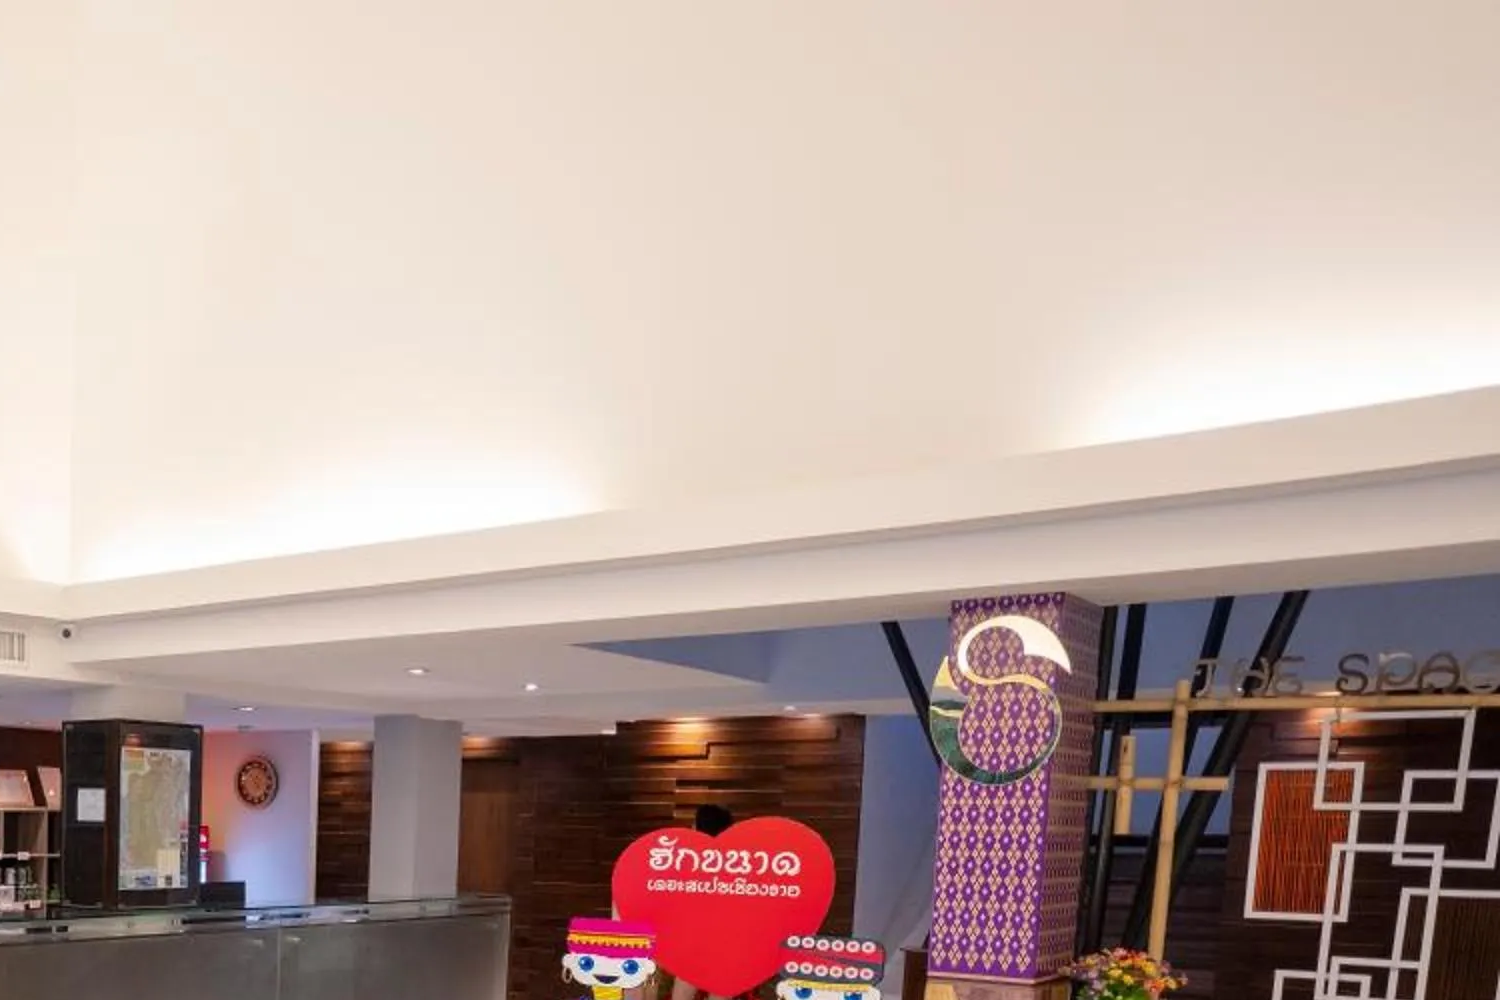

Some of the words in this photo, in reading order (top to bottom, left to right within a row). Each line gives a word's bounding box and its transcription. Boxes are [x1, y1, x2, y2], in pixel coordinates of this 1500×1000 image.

[1193, 655, 1304, 698] THE
[648, 835, 801, 876] ฮักขนาด
